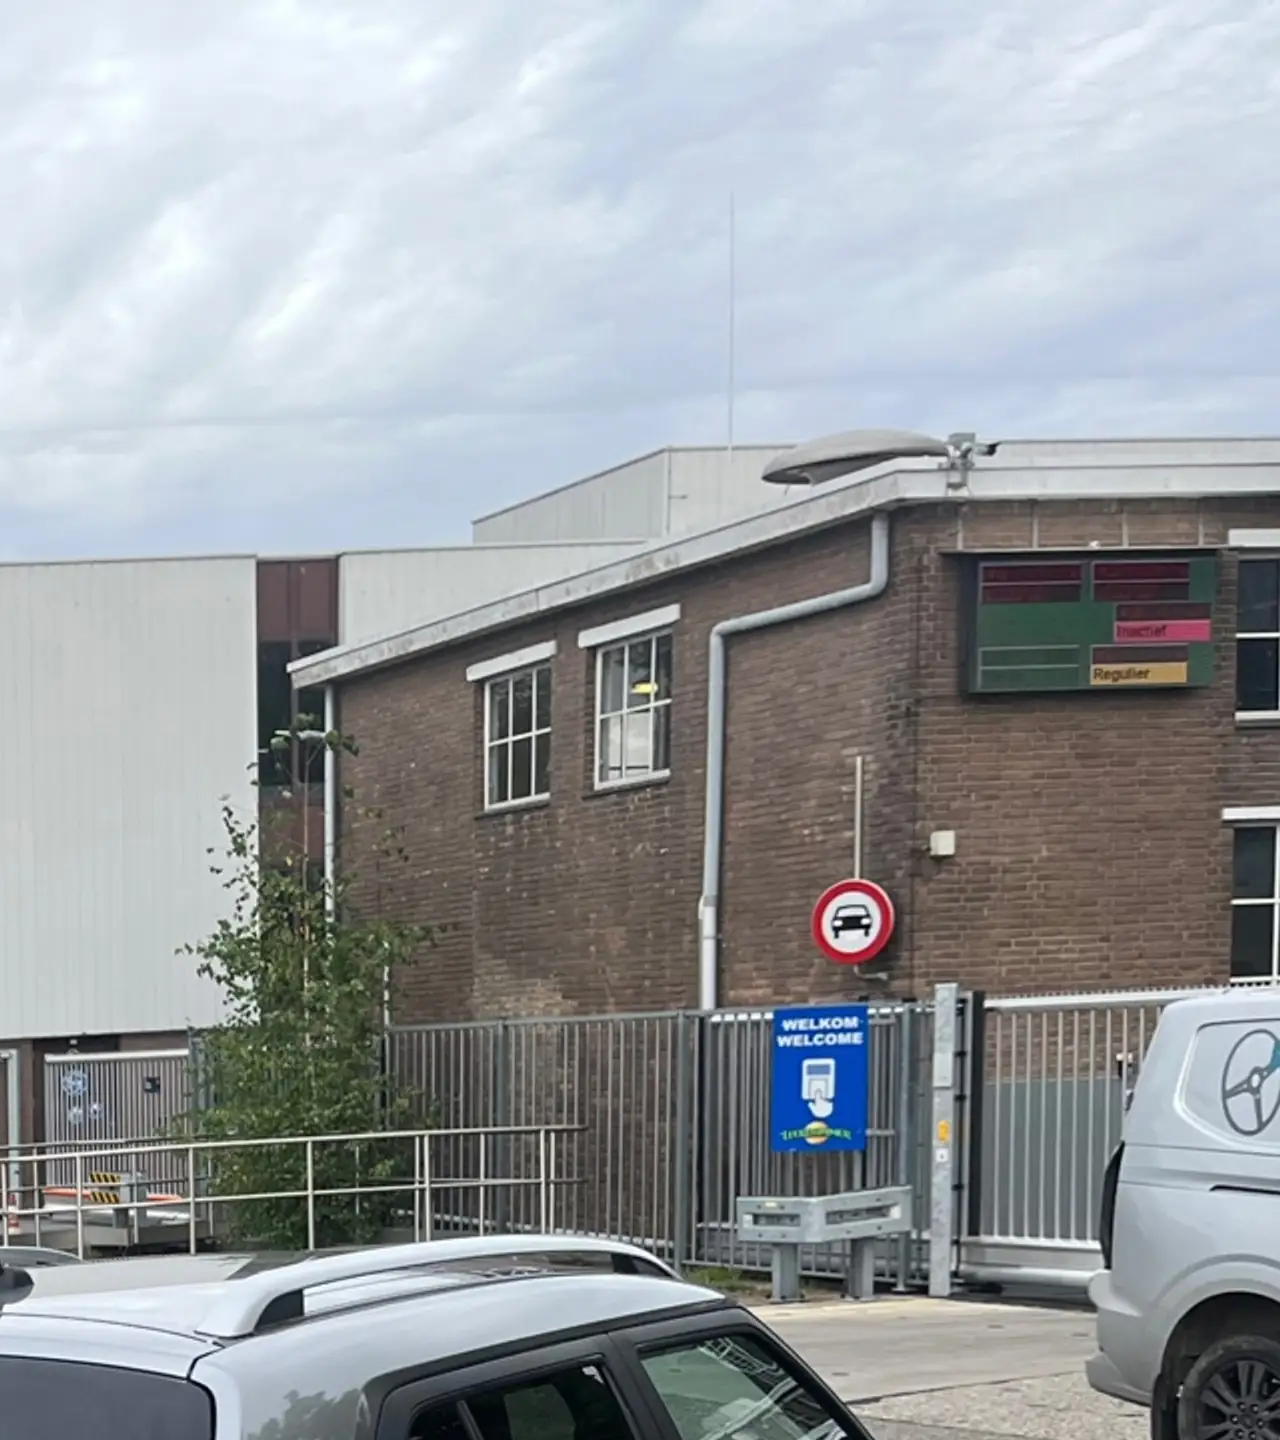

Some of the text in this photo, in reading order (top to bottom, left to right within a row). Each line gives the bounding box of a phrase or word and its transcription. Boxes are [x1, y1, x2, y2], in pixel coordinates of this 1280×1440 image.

[1093, 667, 1151, 683] Regulier
[782, 1016, 859, 1031] WELKOM
[776, 1032, 864, 1047] WELCOME
